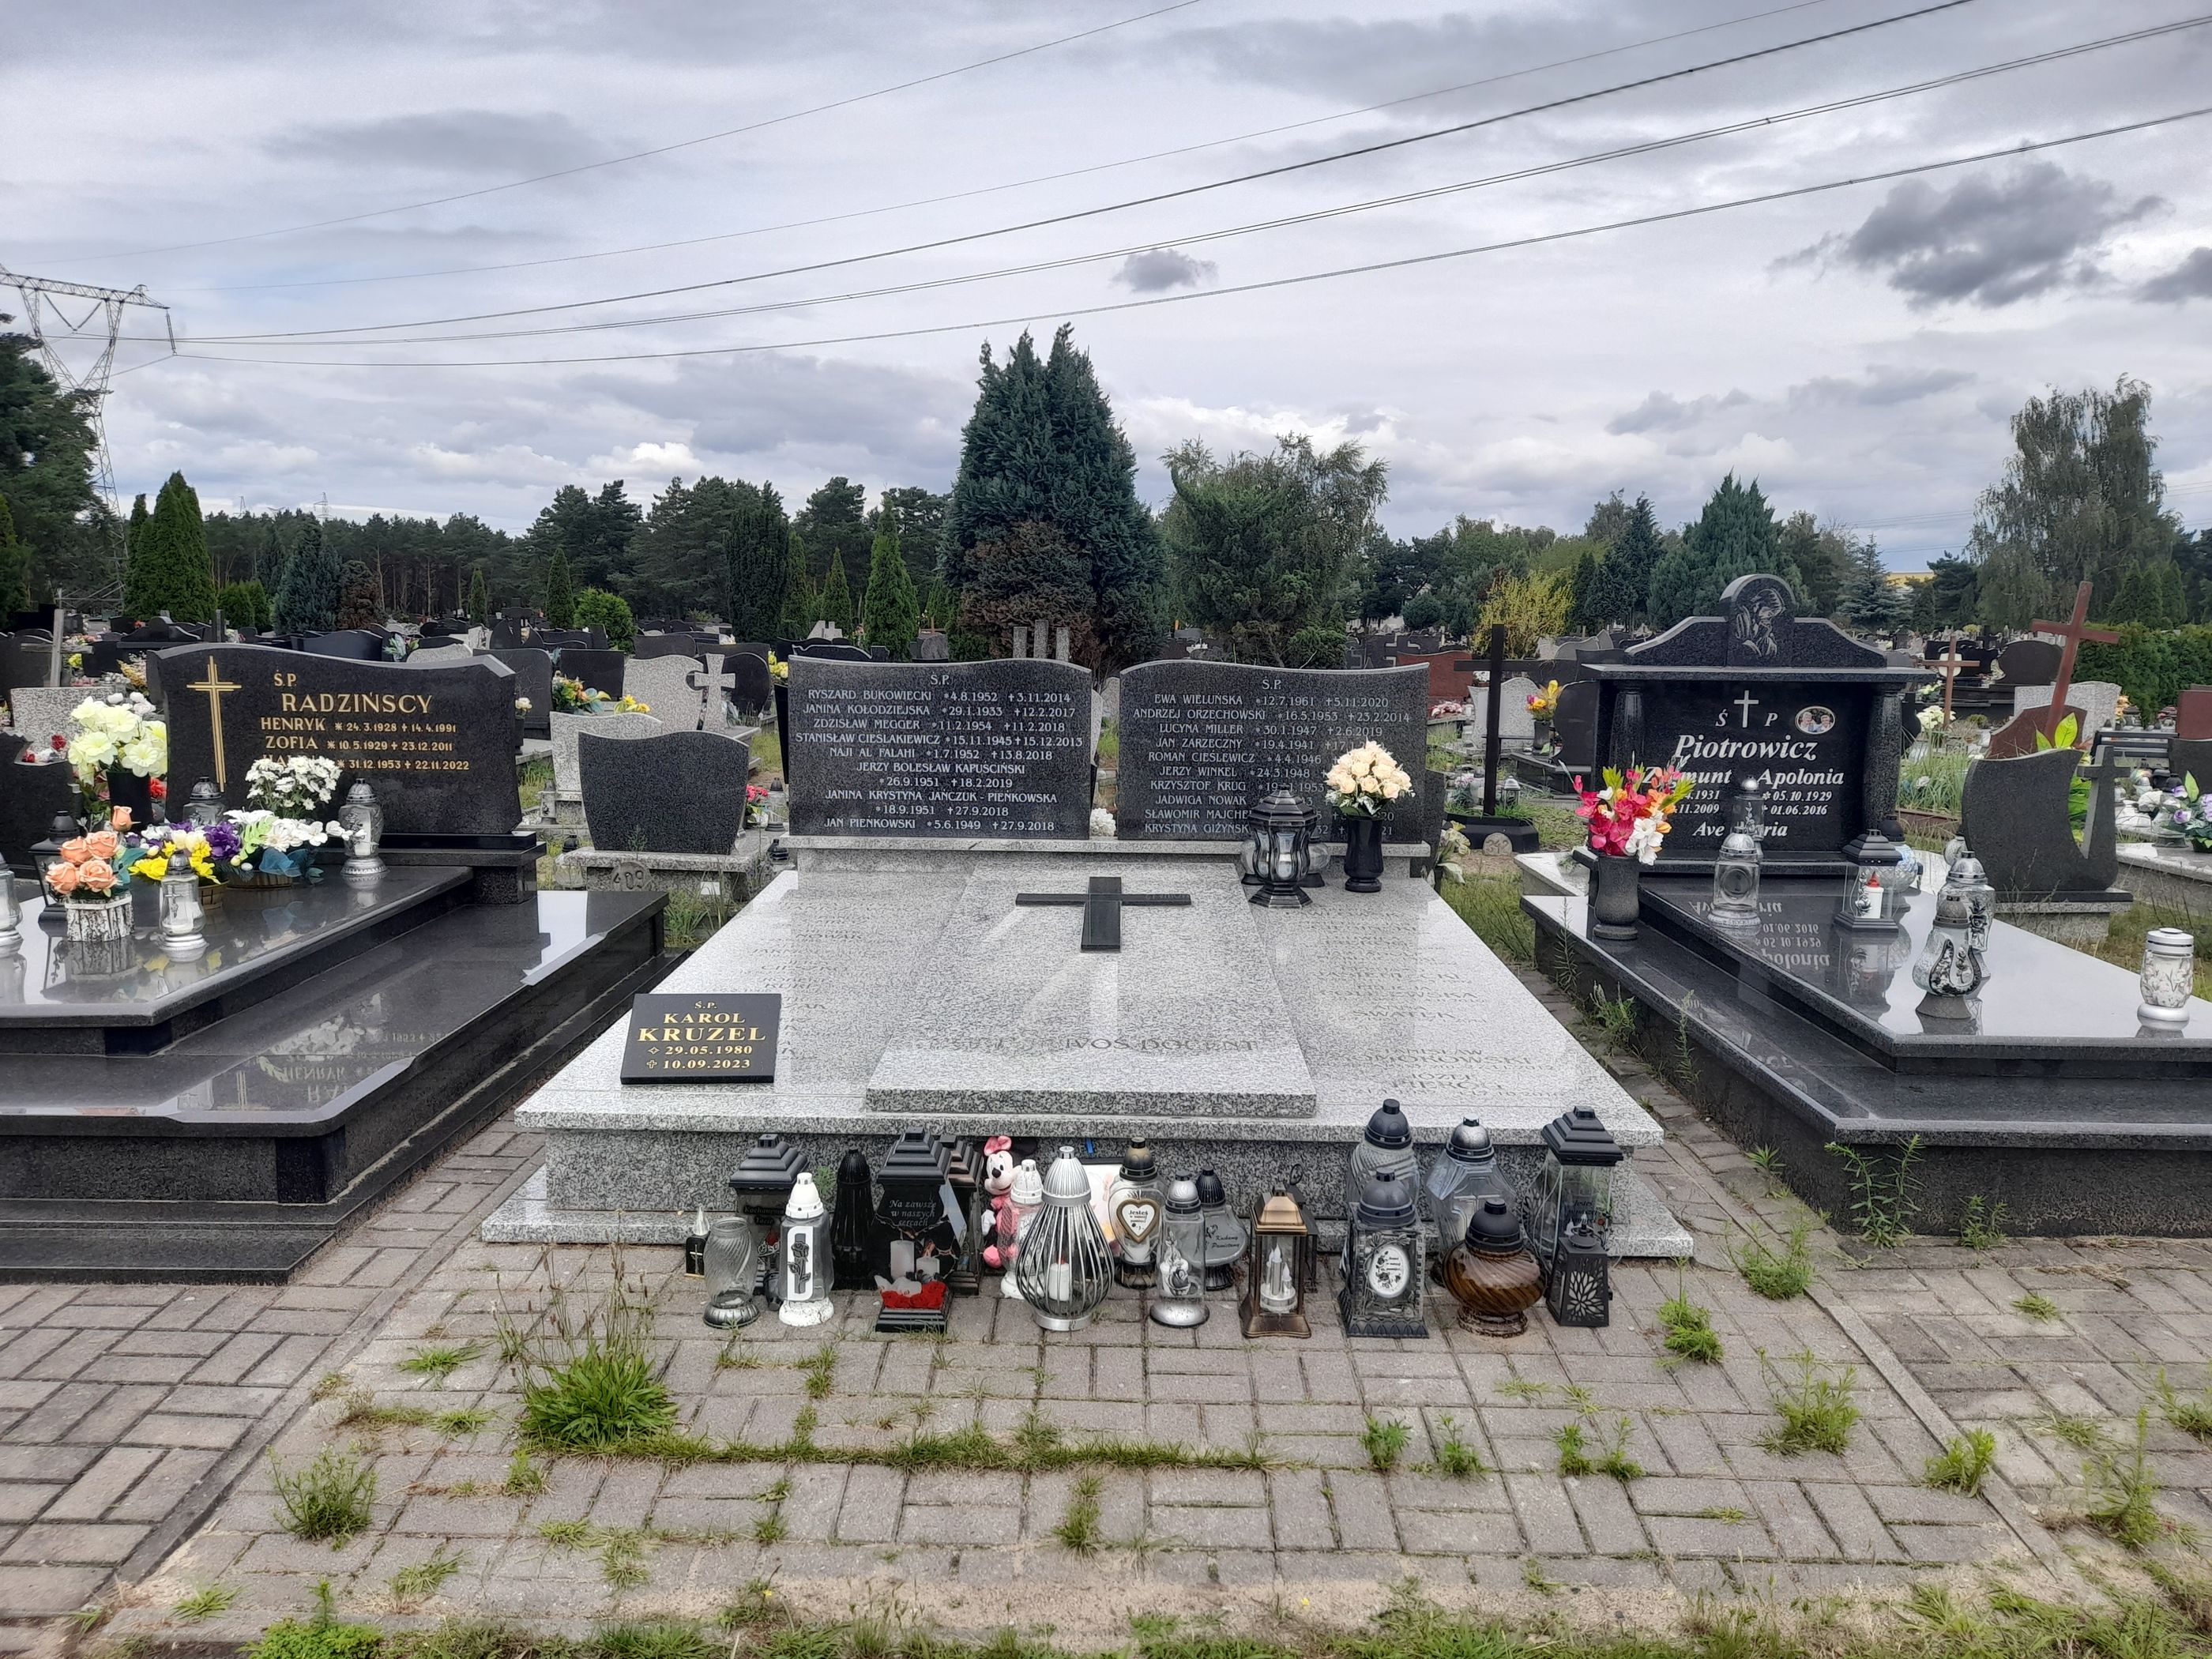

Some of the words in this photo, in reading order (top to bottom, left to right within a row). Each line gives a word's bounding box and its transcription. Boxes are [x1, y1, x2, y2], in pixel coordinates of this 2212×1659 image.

[808, 689, 856, 700] RYSZARD
[863, 690, 932, 702] BUKOWIECKI
[950, 692, 998, 702] 4.8.1952
[1017, 693, 1071, 703] 3.11.2014
[1155, 694, 1176, 704] EWA
[1183, 693, 1243, 705] WIELUŃSKA
[1263, 697, 1315, 706] 12.7.1961
[1334, 698, 1389, 707] 5.11.2020
[281, 692, 432, 713] RADZIŃSCY
[803, 705, 841, 714] JANINA
[848, 705, 931, 715] KOŁODZIEJSKA
[950, 706, 1003, 717] 29.1.1933
[1022, 708, 1075, 717] 12.2.2017
[1133, 709, 1180, 719] ANDRZEJ
[1187, 709, 1266, 720] ORZECHOWSKI
[1285, 711, 1338, 720] 16.5.1953
[1357, 713, 1409, 722] 23.2.2014
[261, 717, 326, 731] HENRYK
[1715, 709, 1729, 727] Ś
[1764, 713, 1778, 727] P
[814, 719, 867, 729] ZDZISŁAW
[874, 720, 920, 730] MEGGER
[1013, 722, 1065, 732] 11.2.2018
[1206, 724, 1243, 735] MILLER
[1264, 725, 1317, 735] 30.1.1947
[1335, 727, 1382, 736] 2.6.2019
[265, 736, 318, 750] ZOFIA
[796, 733, 855, 743] STANISŁAW
[858, 732, 940, 744] CIEŚLAKIEWICZ
[953, 735, 1012, 746] 15.11.1945
[1156, 738, 1176, 747] JAN
[1182, 739, 1243, 749] ZARZECZNY
[1263, 740, 1314, 750] 19.4.1941
[830, 747, 853, 757] NAJI
[879, 748, 915, 758] FALAHI
[934, 750, 980, 759] 1.7.1952
[1000, 750, 1052, 760] 13.8.2018
[1674, 735, 1818, 761] Piotrowicz
[1149, 752, 1185, 762] ROMAN
[1191, 750, 1255, 763] CIEŚLEWICZ
[1275, 755, 1322, 765] 4.4.1946
[856, 762, 890, 771] JERZY
[893, 763, 951, 773] BOLESŁAW
[955, 762, 1025, 774] KAPUŚCIŃSKI
[1160, 766, 1191, 776] JERZY
[1198, 767, 1237, 777] WINKEL
[1258, 768, 1310, 778] 24.3.1948
[886, 777, 939, 787] 26.9.1951
[961, 778, 1013, 788] 18.2.2019
[1642, 766, 1732, 788] Zmunt
[1757, 768, 1844, 790] Apolonia
[1150, 781, 1211, 790] KRZYSZTOF
[1217, 782, 1247, 791] KRUG
[826, 790, 863, 799] JANINA
[869, 790, 923, 800] KRYSTYNA
[929, 789, 977, 802] JAŃCZUK
[988, 791, 1057, 803] PIEŃKOWSKA
[1155, 795, 1202, 804] JADWIGA
[1209, 796, 1247, 805] NOWAK
[1773, 791, 1832, 801] 05.10.1929
[883, 805, 935, 814] 18.9.1951
[955, 807, 1009, 816] 27.9.2018
[1146, 809, 1200, 818] SŁAWOMIR
[1206, 810, 1251, 818] MAJCHE
[1770, 804, 1828, 815] 01.06.2016
[824, 818, 844, 828] JAN
[850, 816, 916, 829] PIEŃKOWSKI
[934, 820, 981, 830] 5.6.1949
[1001, 822, 1055, 831] 27.9.2018
[1146, 823, 1198, 833] KRYSTYNA
[1204, 822, 1250, 833] GIŻYŃSK
[1692, 822, 1725, 836] Ave
[664, 1013, 746, 1024] KAROL
[637, 1027, 766, 1042] KRUZEL
[665, 1046, 753, 1055] 29.05.1980
[663, 1060, 751, 1069] 10.09.2023
[890, 1199, 902, 1208] Na
